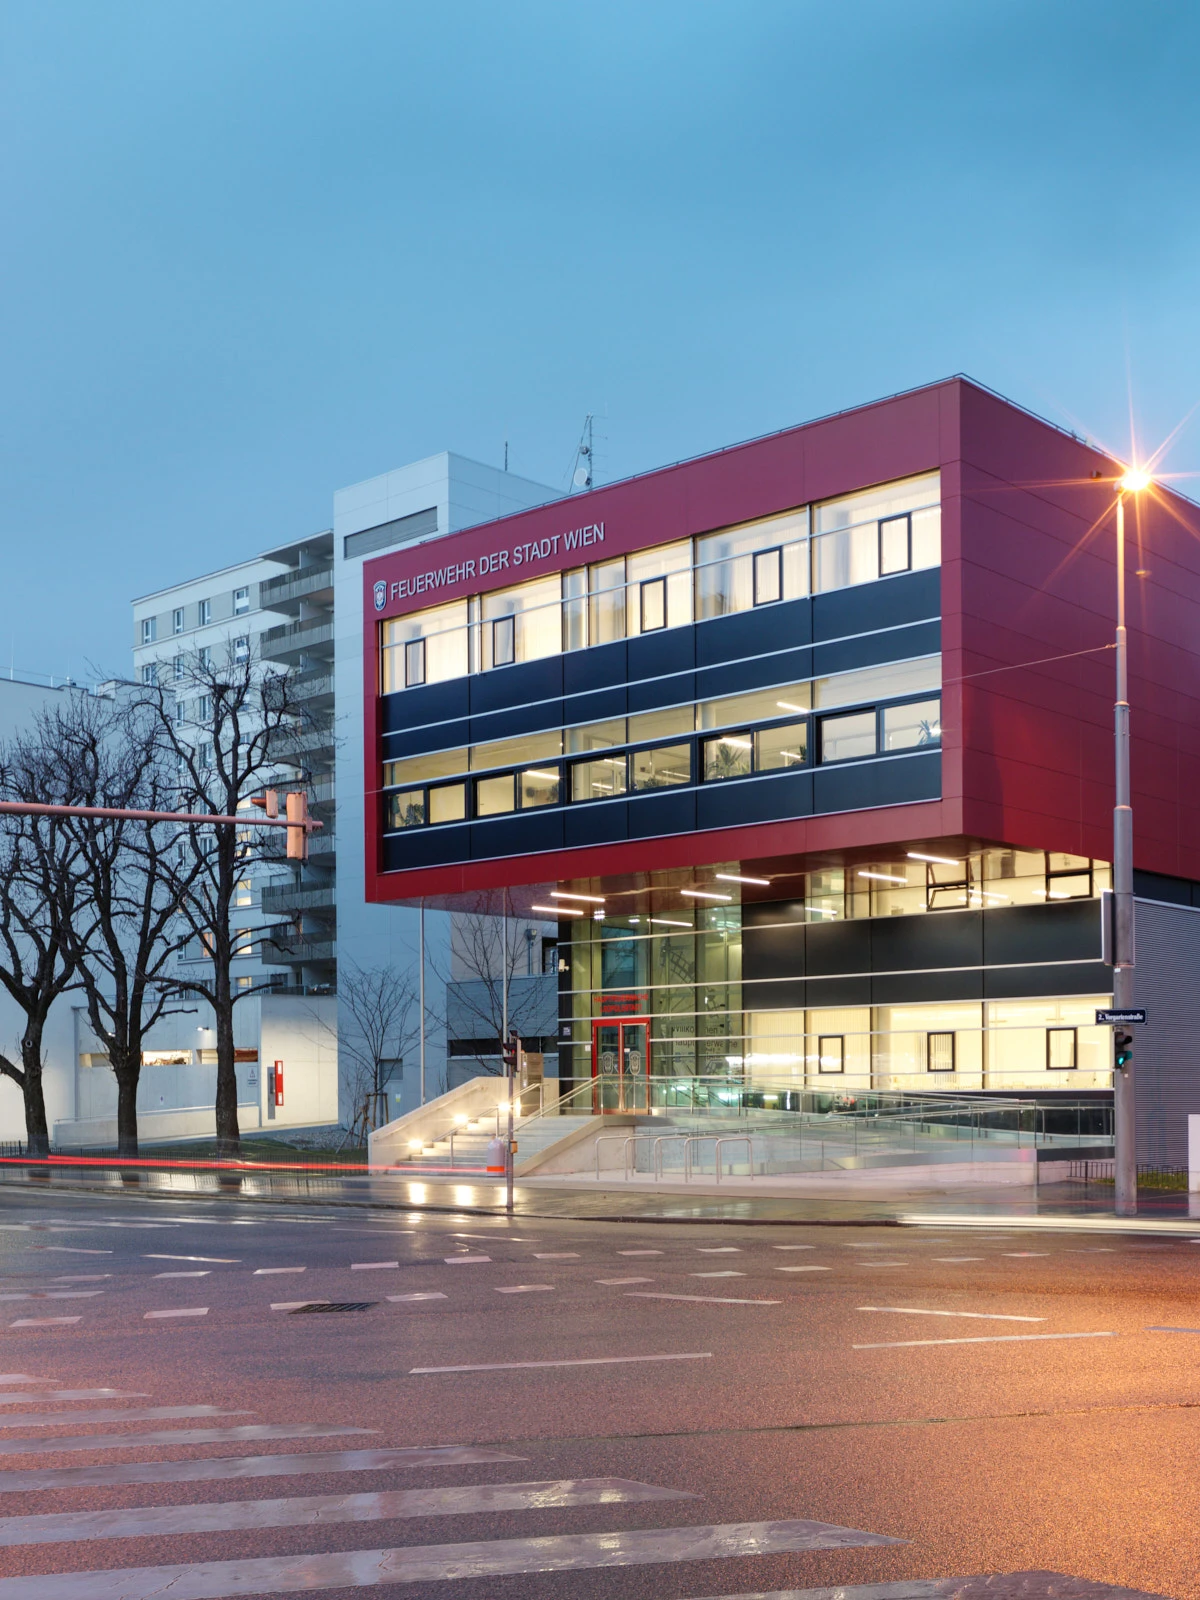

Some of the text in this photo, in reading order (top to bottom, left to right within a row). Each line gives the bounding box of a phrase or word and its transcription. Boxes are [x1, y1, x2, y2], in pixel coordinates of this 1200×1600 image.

[390, 522, 605, 600] FEUERWEHR DER STADT WIEN
[1105, 1013, 1143, 1022] Vorgartenstraße
